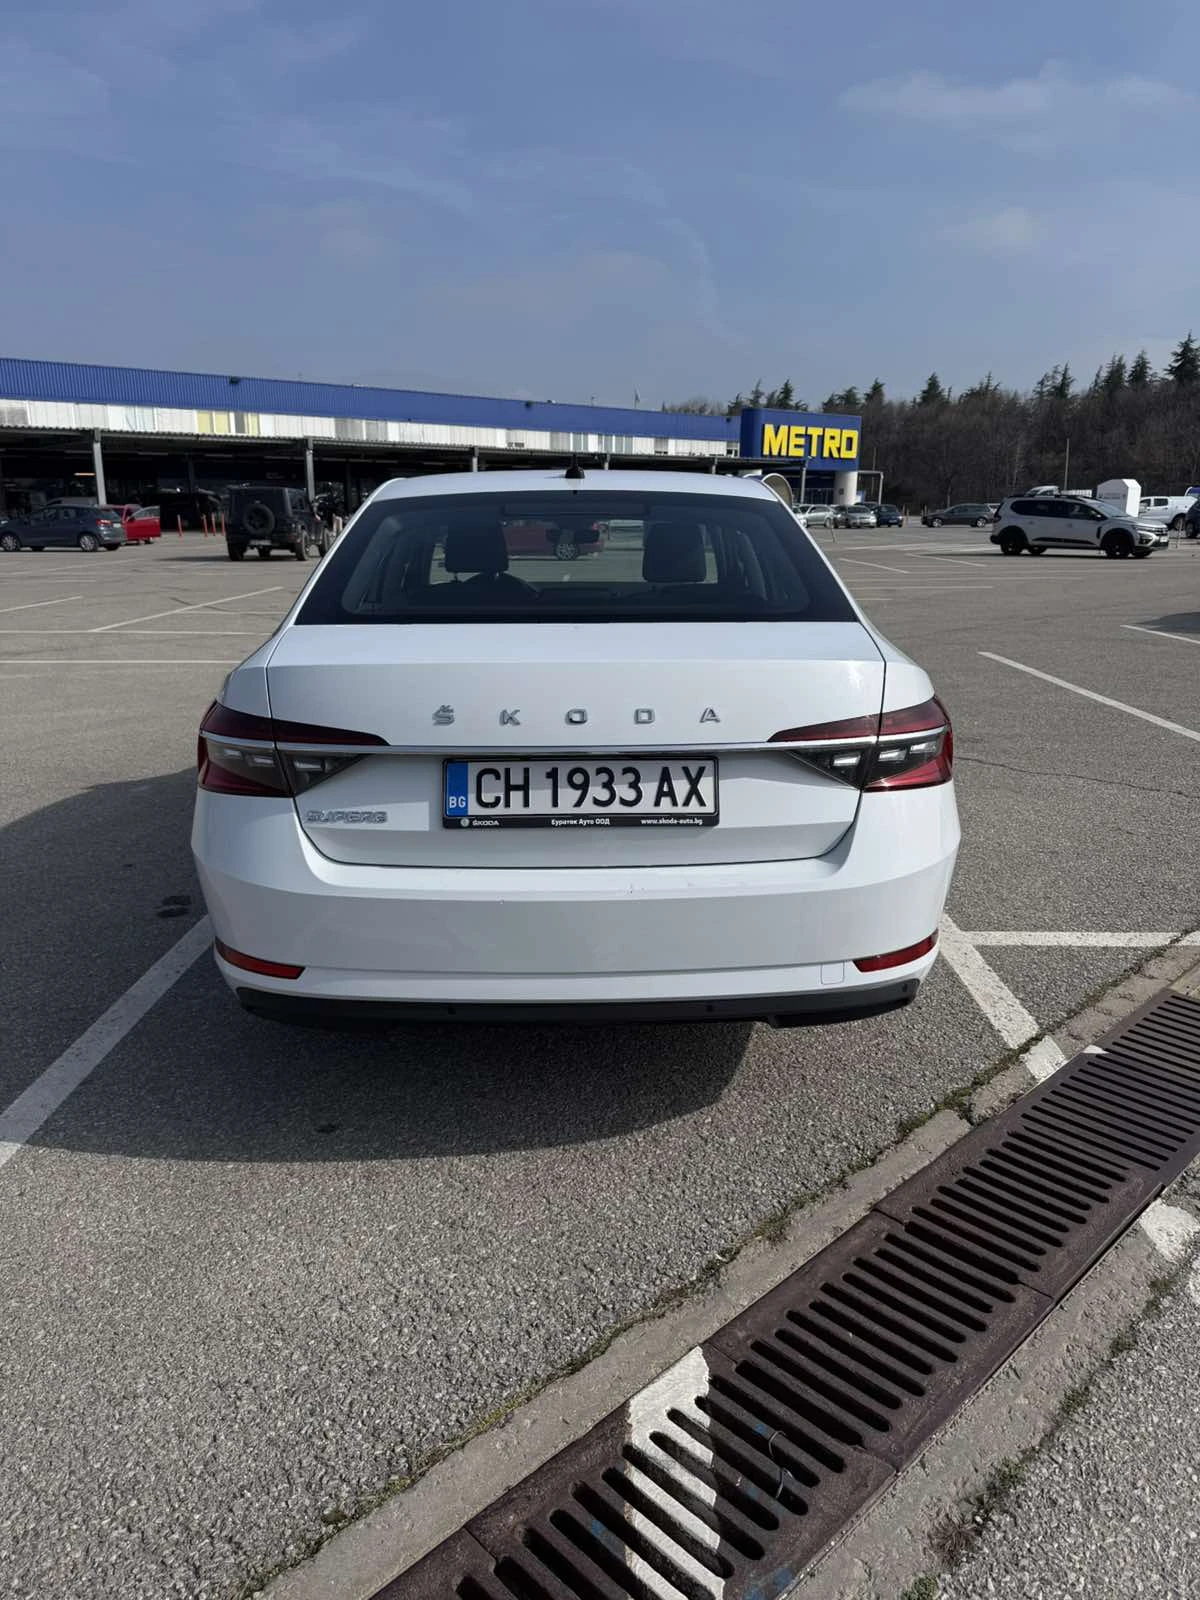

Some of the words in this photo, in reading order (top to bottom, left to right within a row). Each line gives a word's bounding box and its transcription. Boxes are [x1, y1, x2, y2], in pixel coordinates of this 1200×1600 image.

[763, 424, 858, 458] METRO
[432, 704, 720, 726] ŠKODA
[475, 767, 530, 808] CH
[545, 766, 643, 808] 1933
[653, 766, 707, 807] AX
[449, 796, 466, 808] BG
[305, 810, 387, 824] SUPERB
[641, 817, 703, 826] www.skoda-auto.bg
